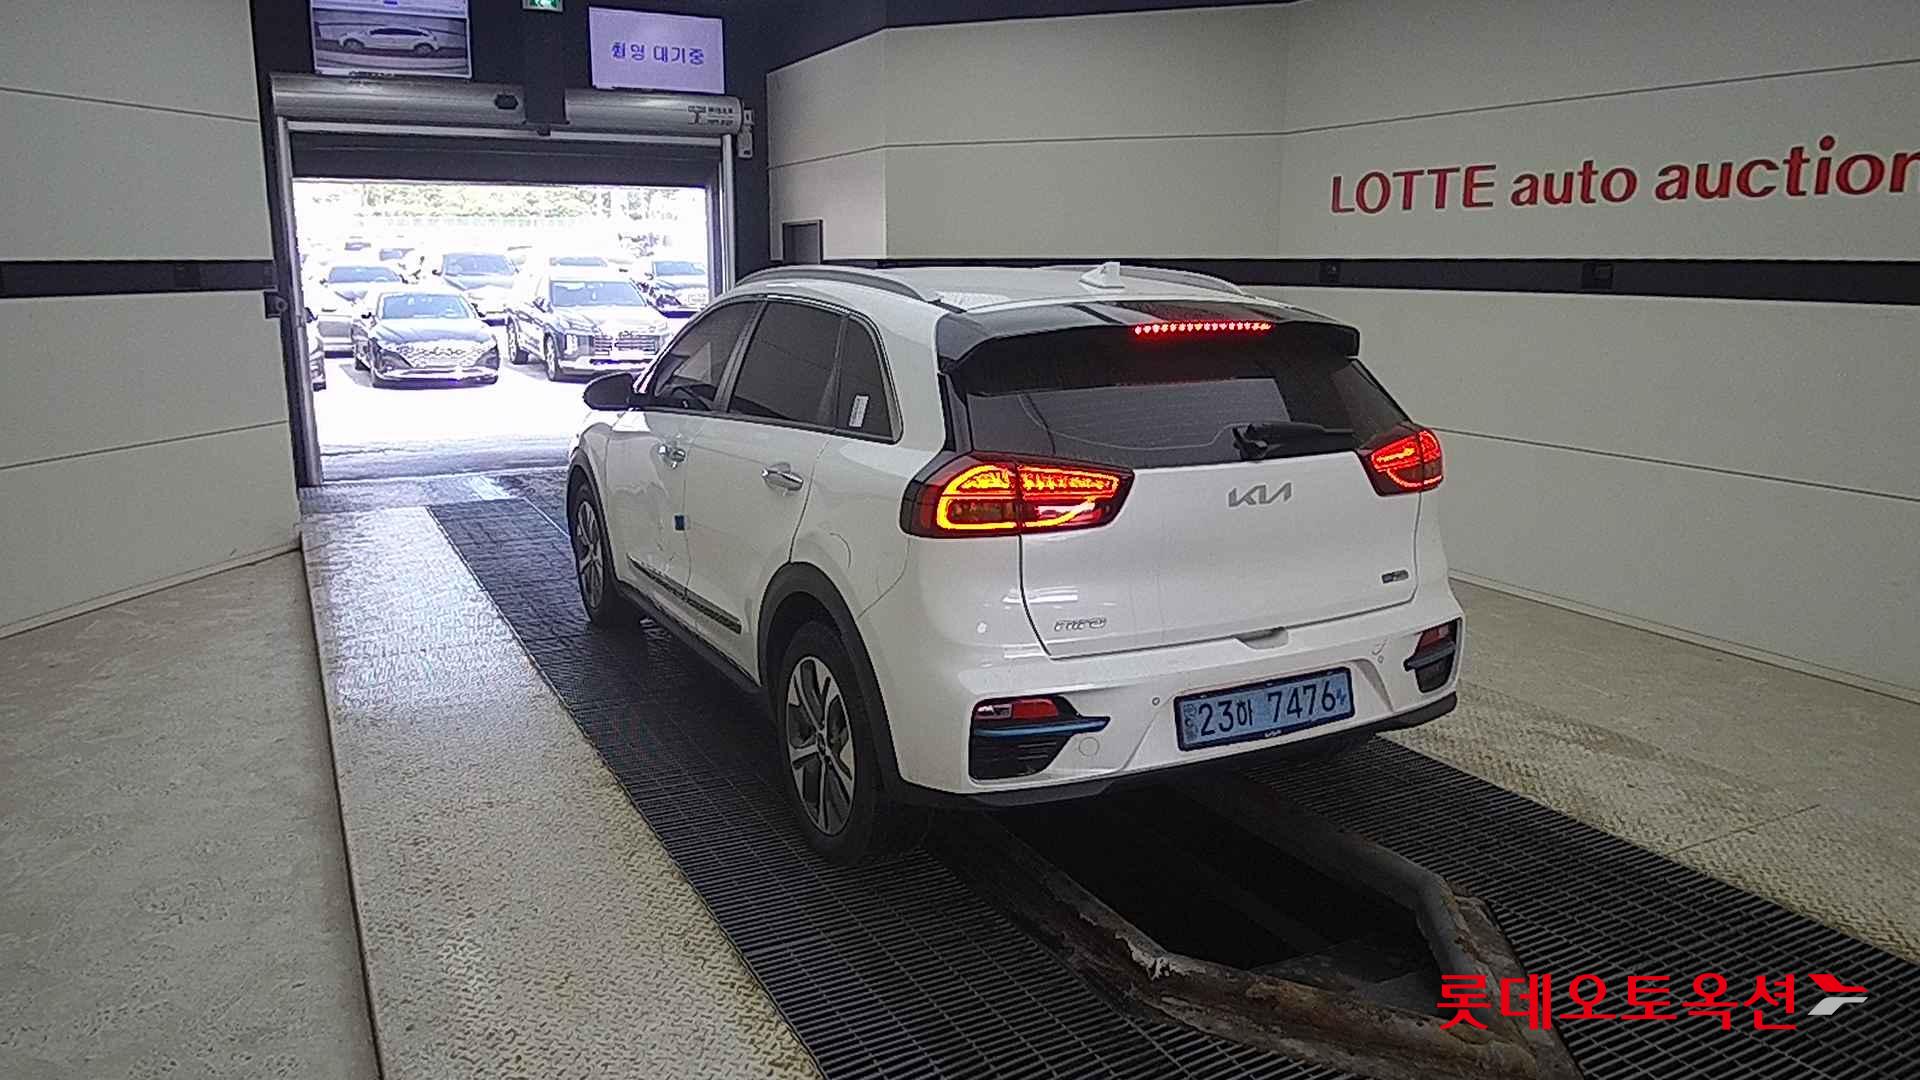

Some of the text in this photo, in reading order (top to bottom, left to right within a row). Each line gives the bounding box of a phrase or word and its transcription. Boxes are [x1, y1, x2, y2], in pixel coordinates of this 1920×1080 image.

[653, 45, 705, 65] 대기중
[1330, 164, 1497, 214] LOTTE
[1511, 160, 1638, 206] auto
[1228, 482, 1292, 507] KIA
[1267, 682, 1336, 723] 7476
